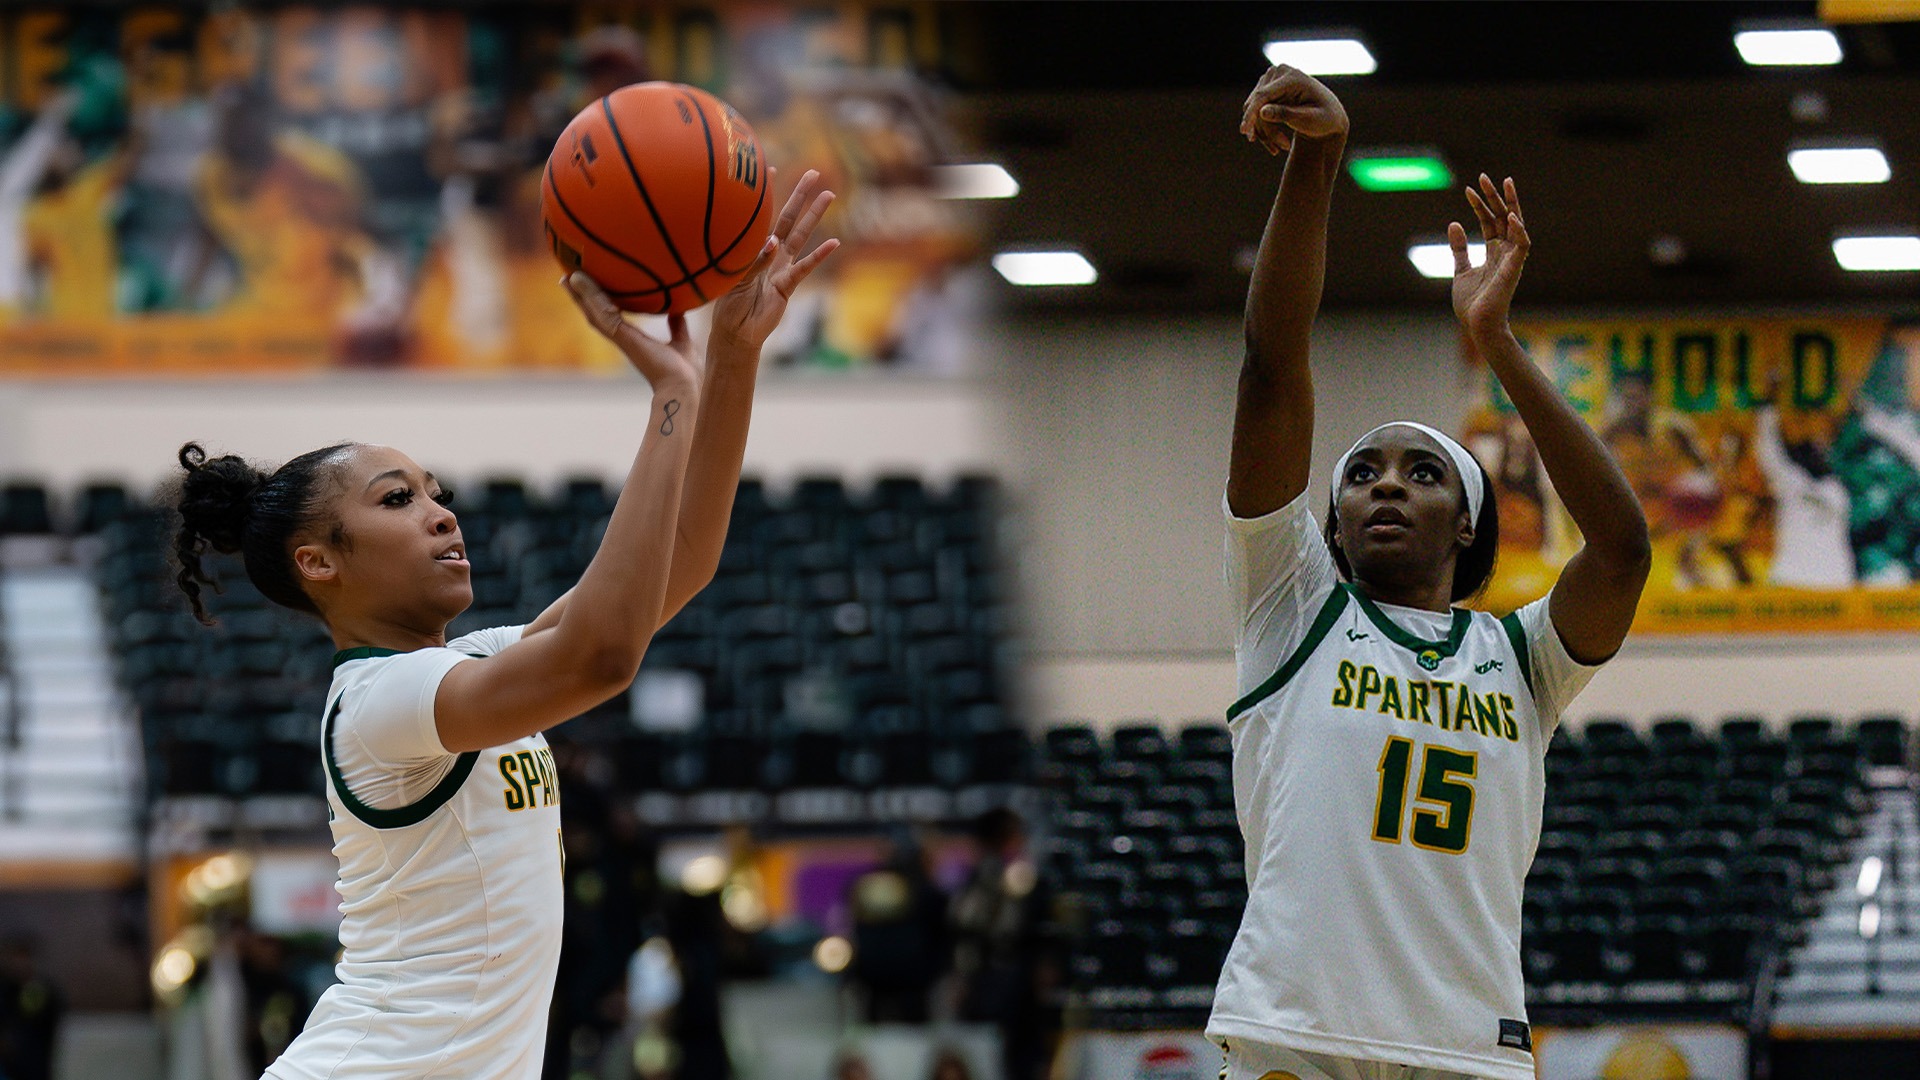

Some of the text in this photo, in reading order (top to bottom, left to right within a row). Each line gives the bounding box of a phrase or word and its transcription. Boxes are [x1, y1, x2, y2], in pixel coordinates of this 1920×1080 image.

[1331, 660, 1519, 742] SPARTANS
[497, 749, 561, 812] SPA
[1371, 735, 1478, 855] 15
